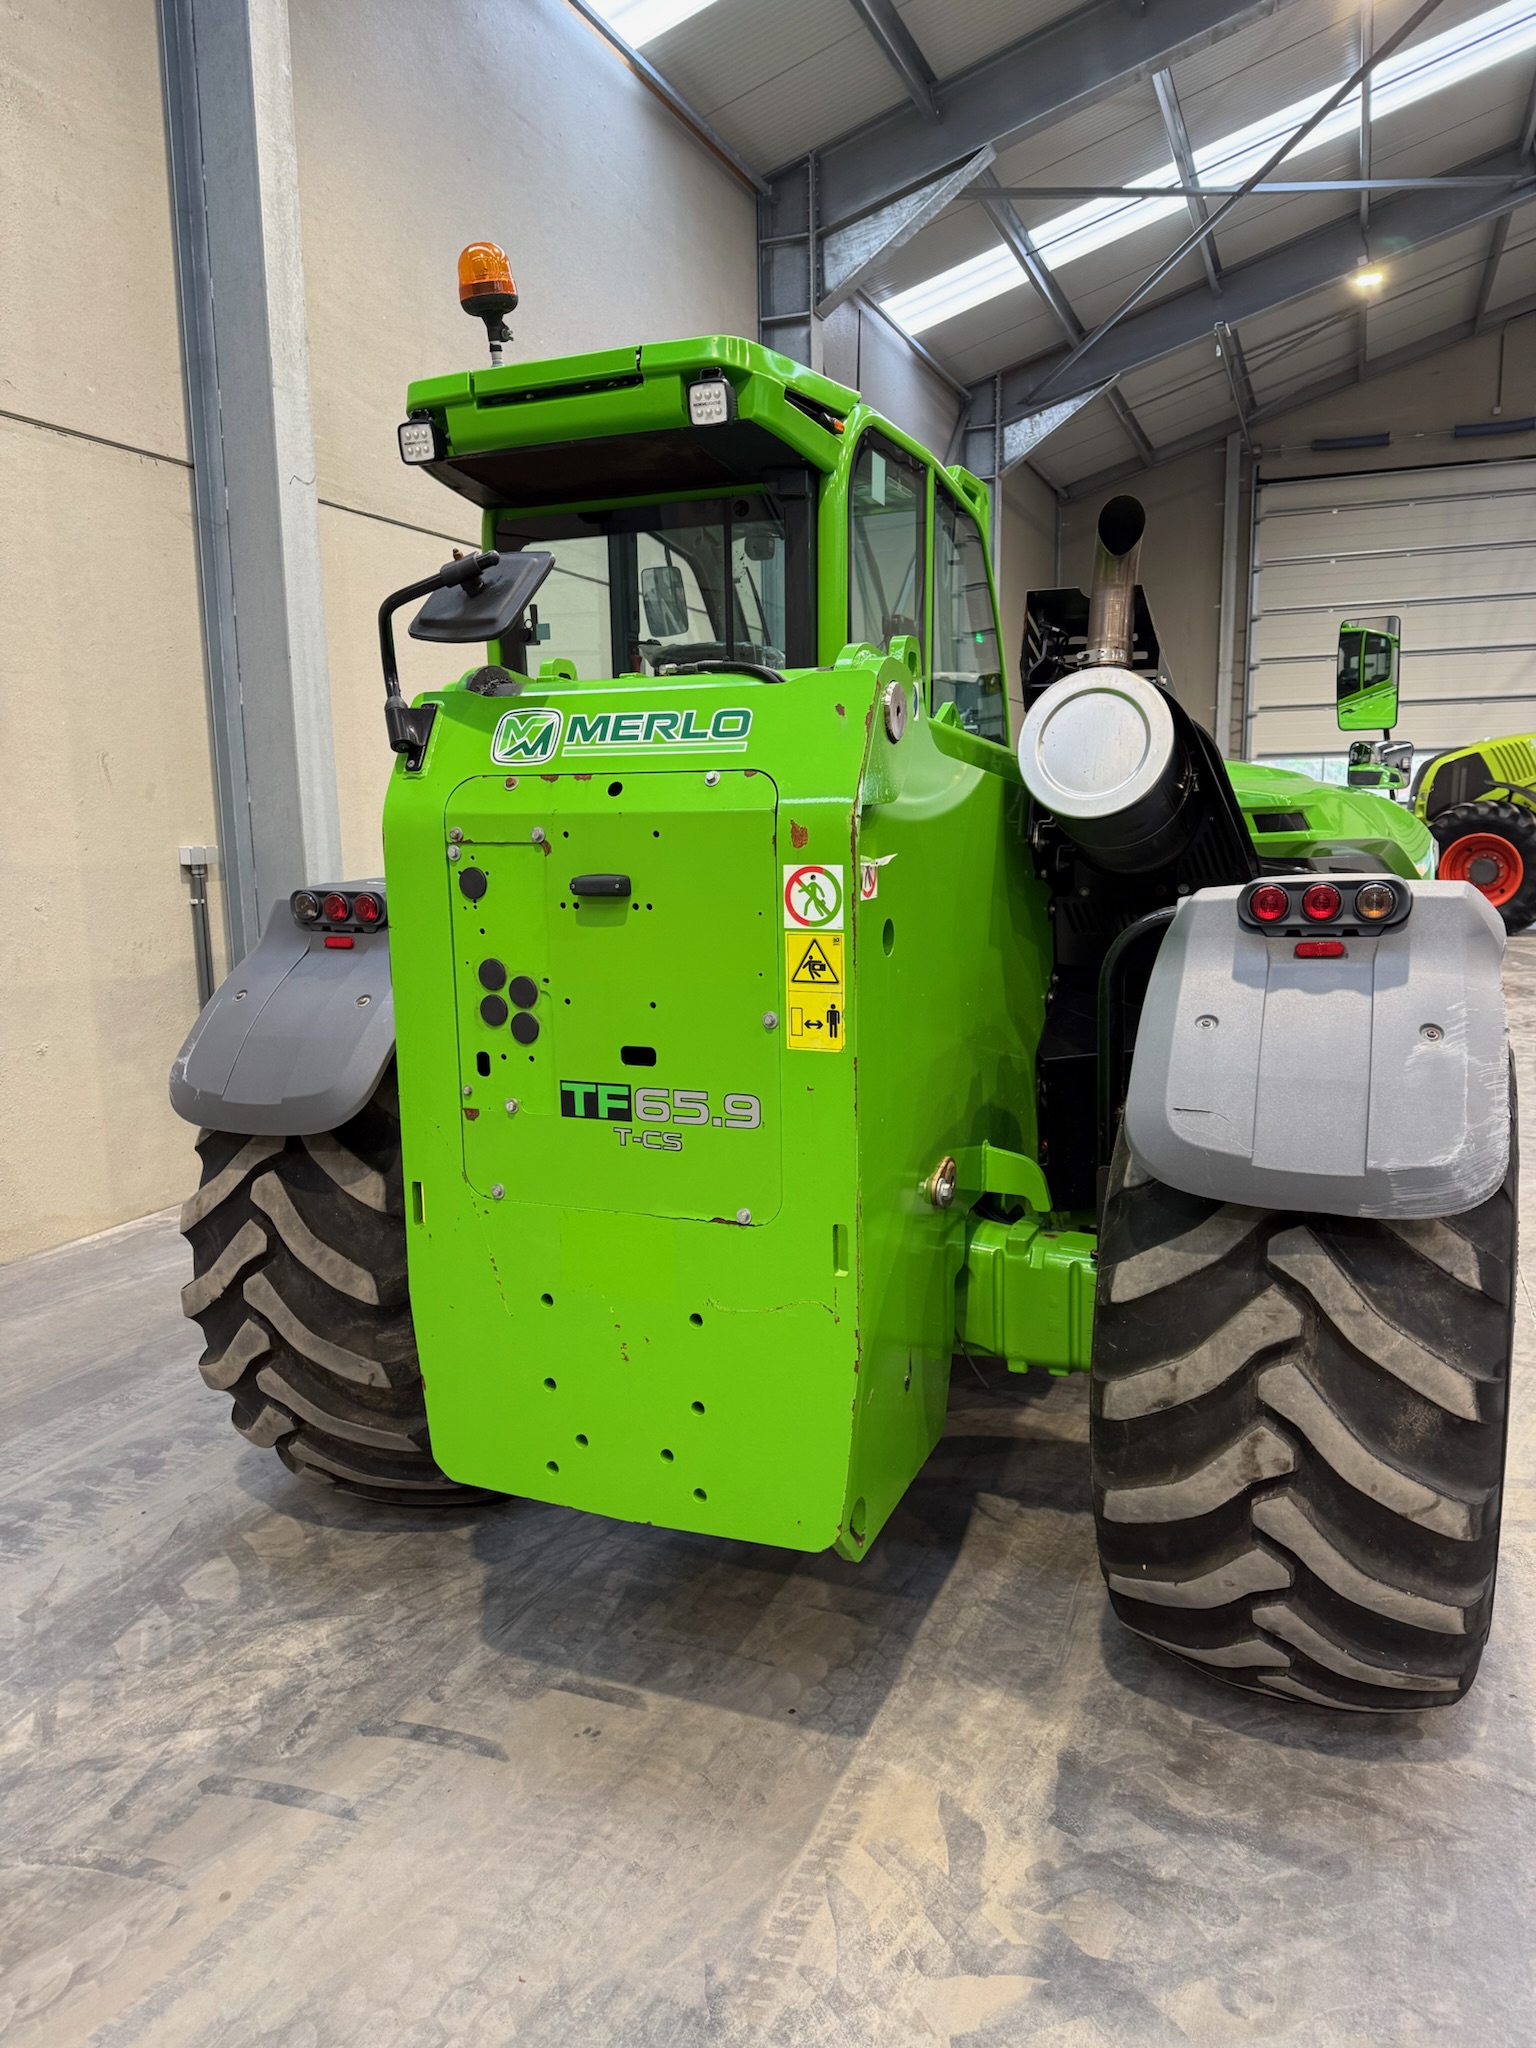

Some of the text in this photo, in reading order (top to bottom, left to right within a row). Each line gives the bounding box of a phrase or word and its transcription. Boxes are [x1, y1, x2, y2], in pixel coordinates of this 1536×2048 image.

[565, 708, 752, 744] MERLO
[561, 1081, 761, 1129] TF65.9
[613, 1127, 682, 1152] T-CS
